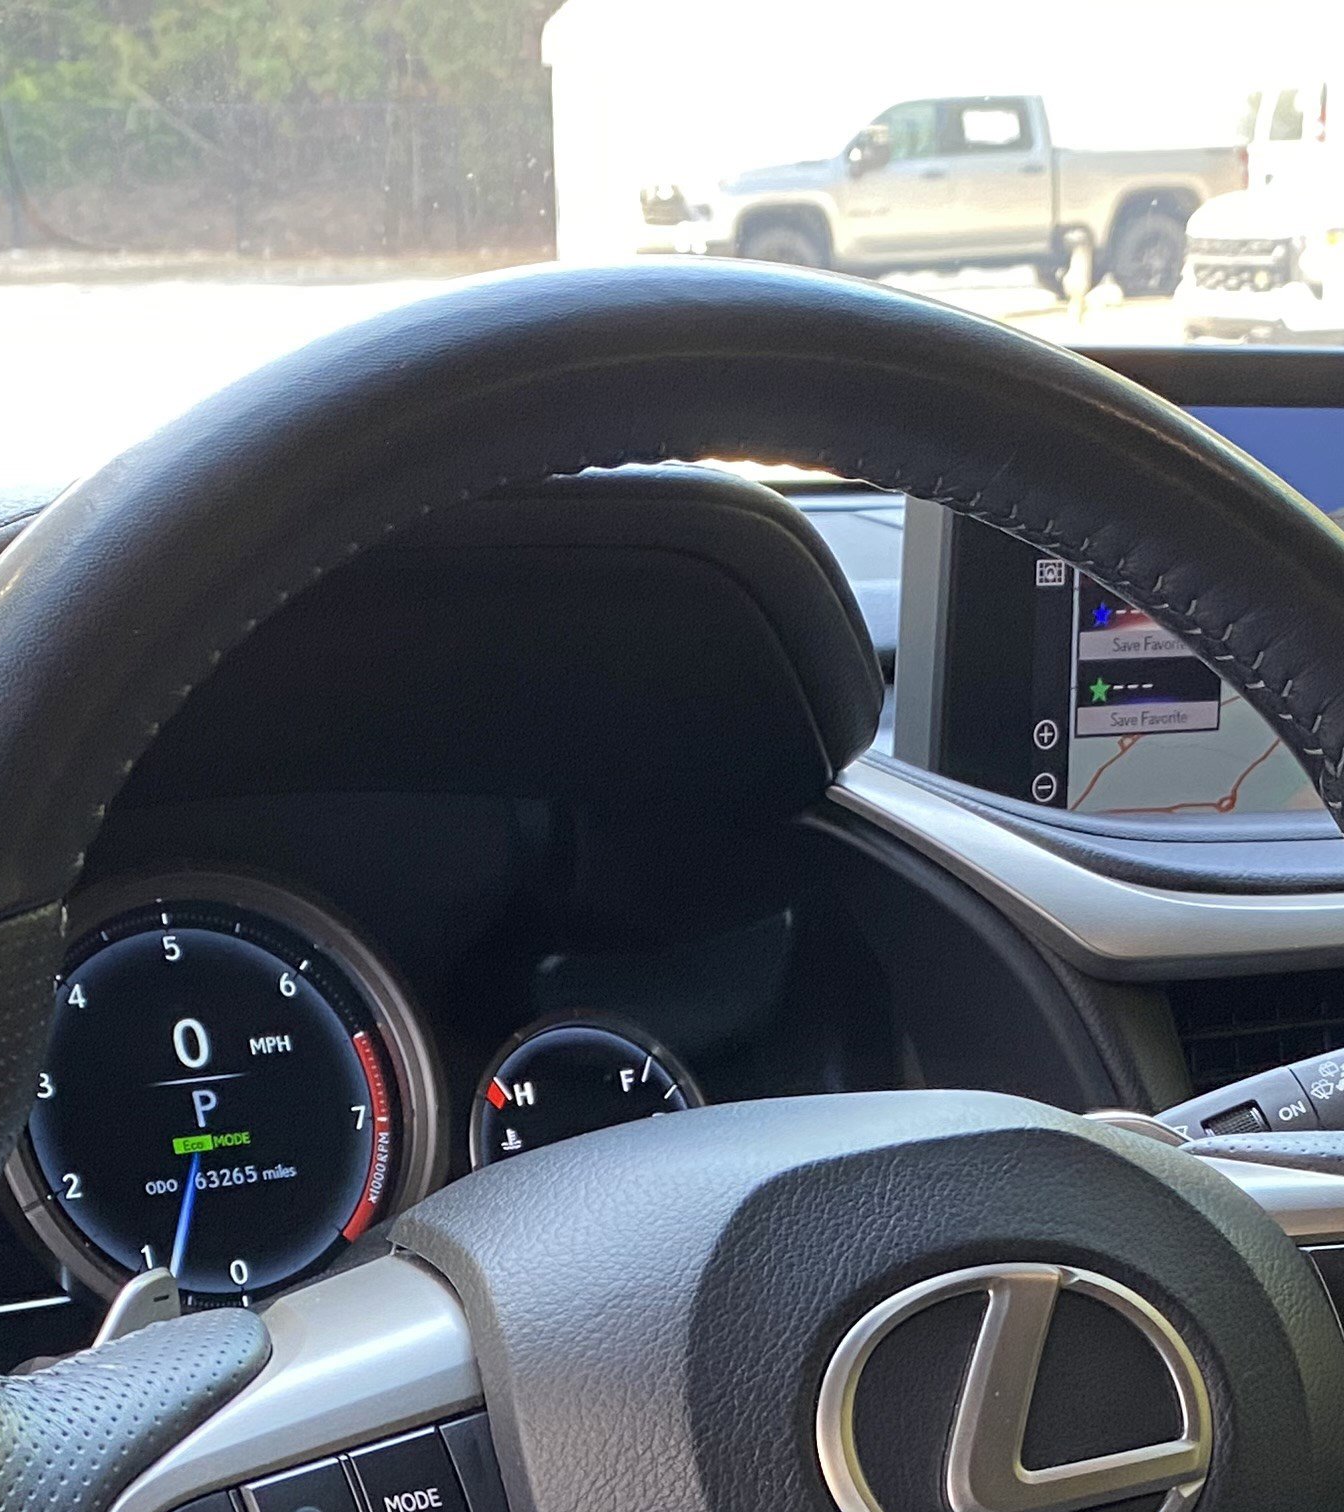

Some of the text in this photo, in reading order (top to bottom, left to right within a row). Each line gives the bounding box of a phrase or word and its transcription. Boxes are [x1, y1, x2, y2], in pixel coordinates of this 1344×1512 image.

[1113, 637, 1141, 652] Save
[1110, 709, 1189, 728] Save Favorite
[162, 935, 182, 962] 5
[67, 983, 87, 1009] 4
[278, 971, 298, 998] 6
[172, 1017, 293, 1070] 0 MPH
[36, 1072, 55, 1100] 3
[513, 1081, 536, 1107] H
[618, 1068, 636, 1093] F
[191, 1089, 218, 1128] P
[350, 1104, 367, 1131] 7
[1277, 1100, 1308, 1122] ON
[213, 1131, 252, 1149] MODE
[61, 1172, 84, 1200] 2
[145, 1163, 297, 1196] ODO 63265 miles
[140, 1244, 155, 1271] 1
[229, 1259, 249, 1286] 0
